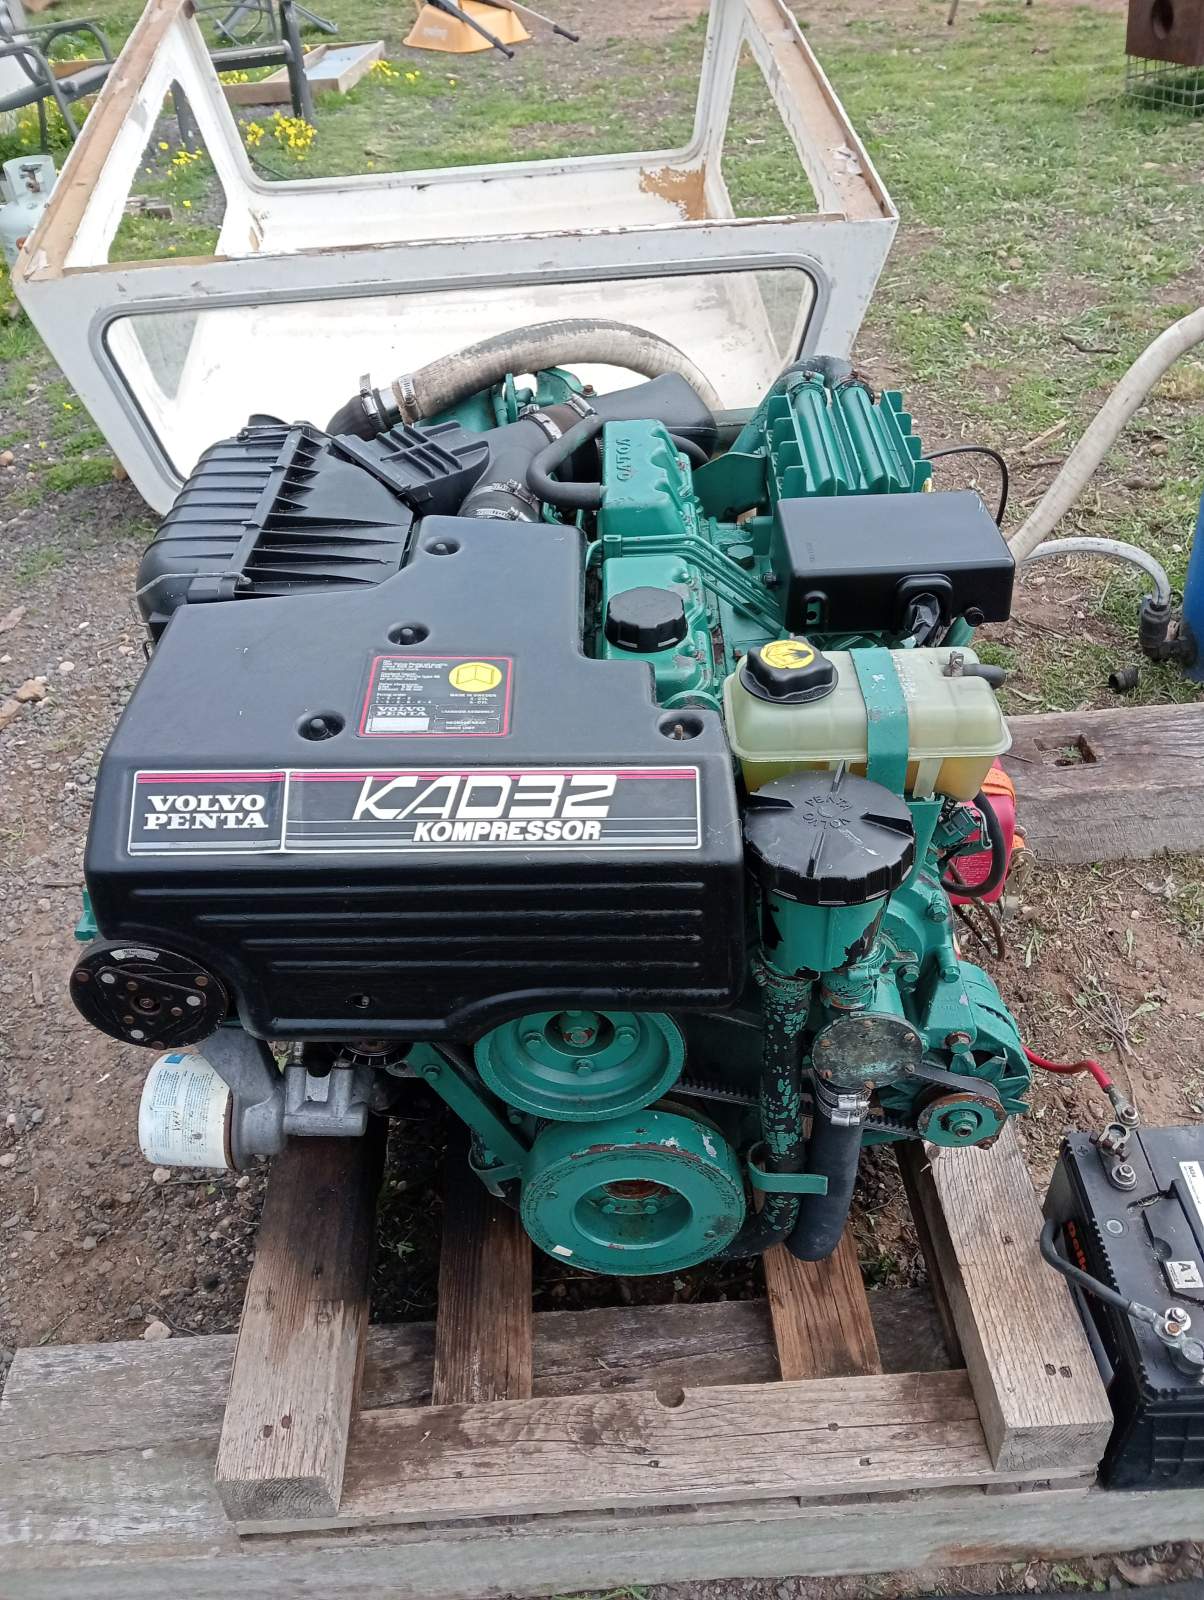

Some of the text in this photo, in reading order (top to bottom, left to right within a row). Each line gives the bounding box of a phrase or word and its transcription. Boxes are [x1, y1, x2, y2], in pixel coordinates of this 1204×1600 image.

[616, 438, 632, 481] VOLVO
[147, 794, 266, 811] VOLVO
[352, 775, 617, 820] KAD32
[143, 812, 269, 829] PENTA
[413, 820, 602, 841] KOMPRESSOR
